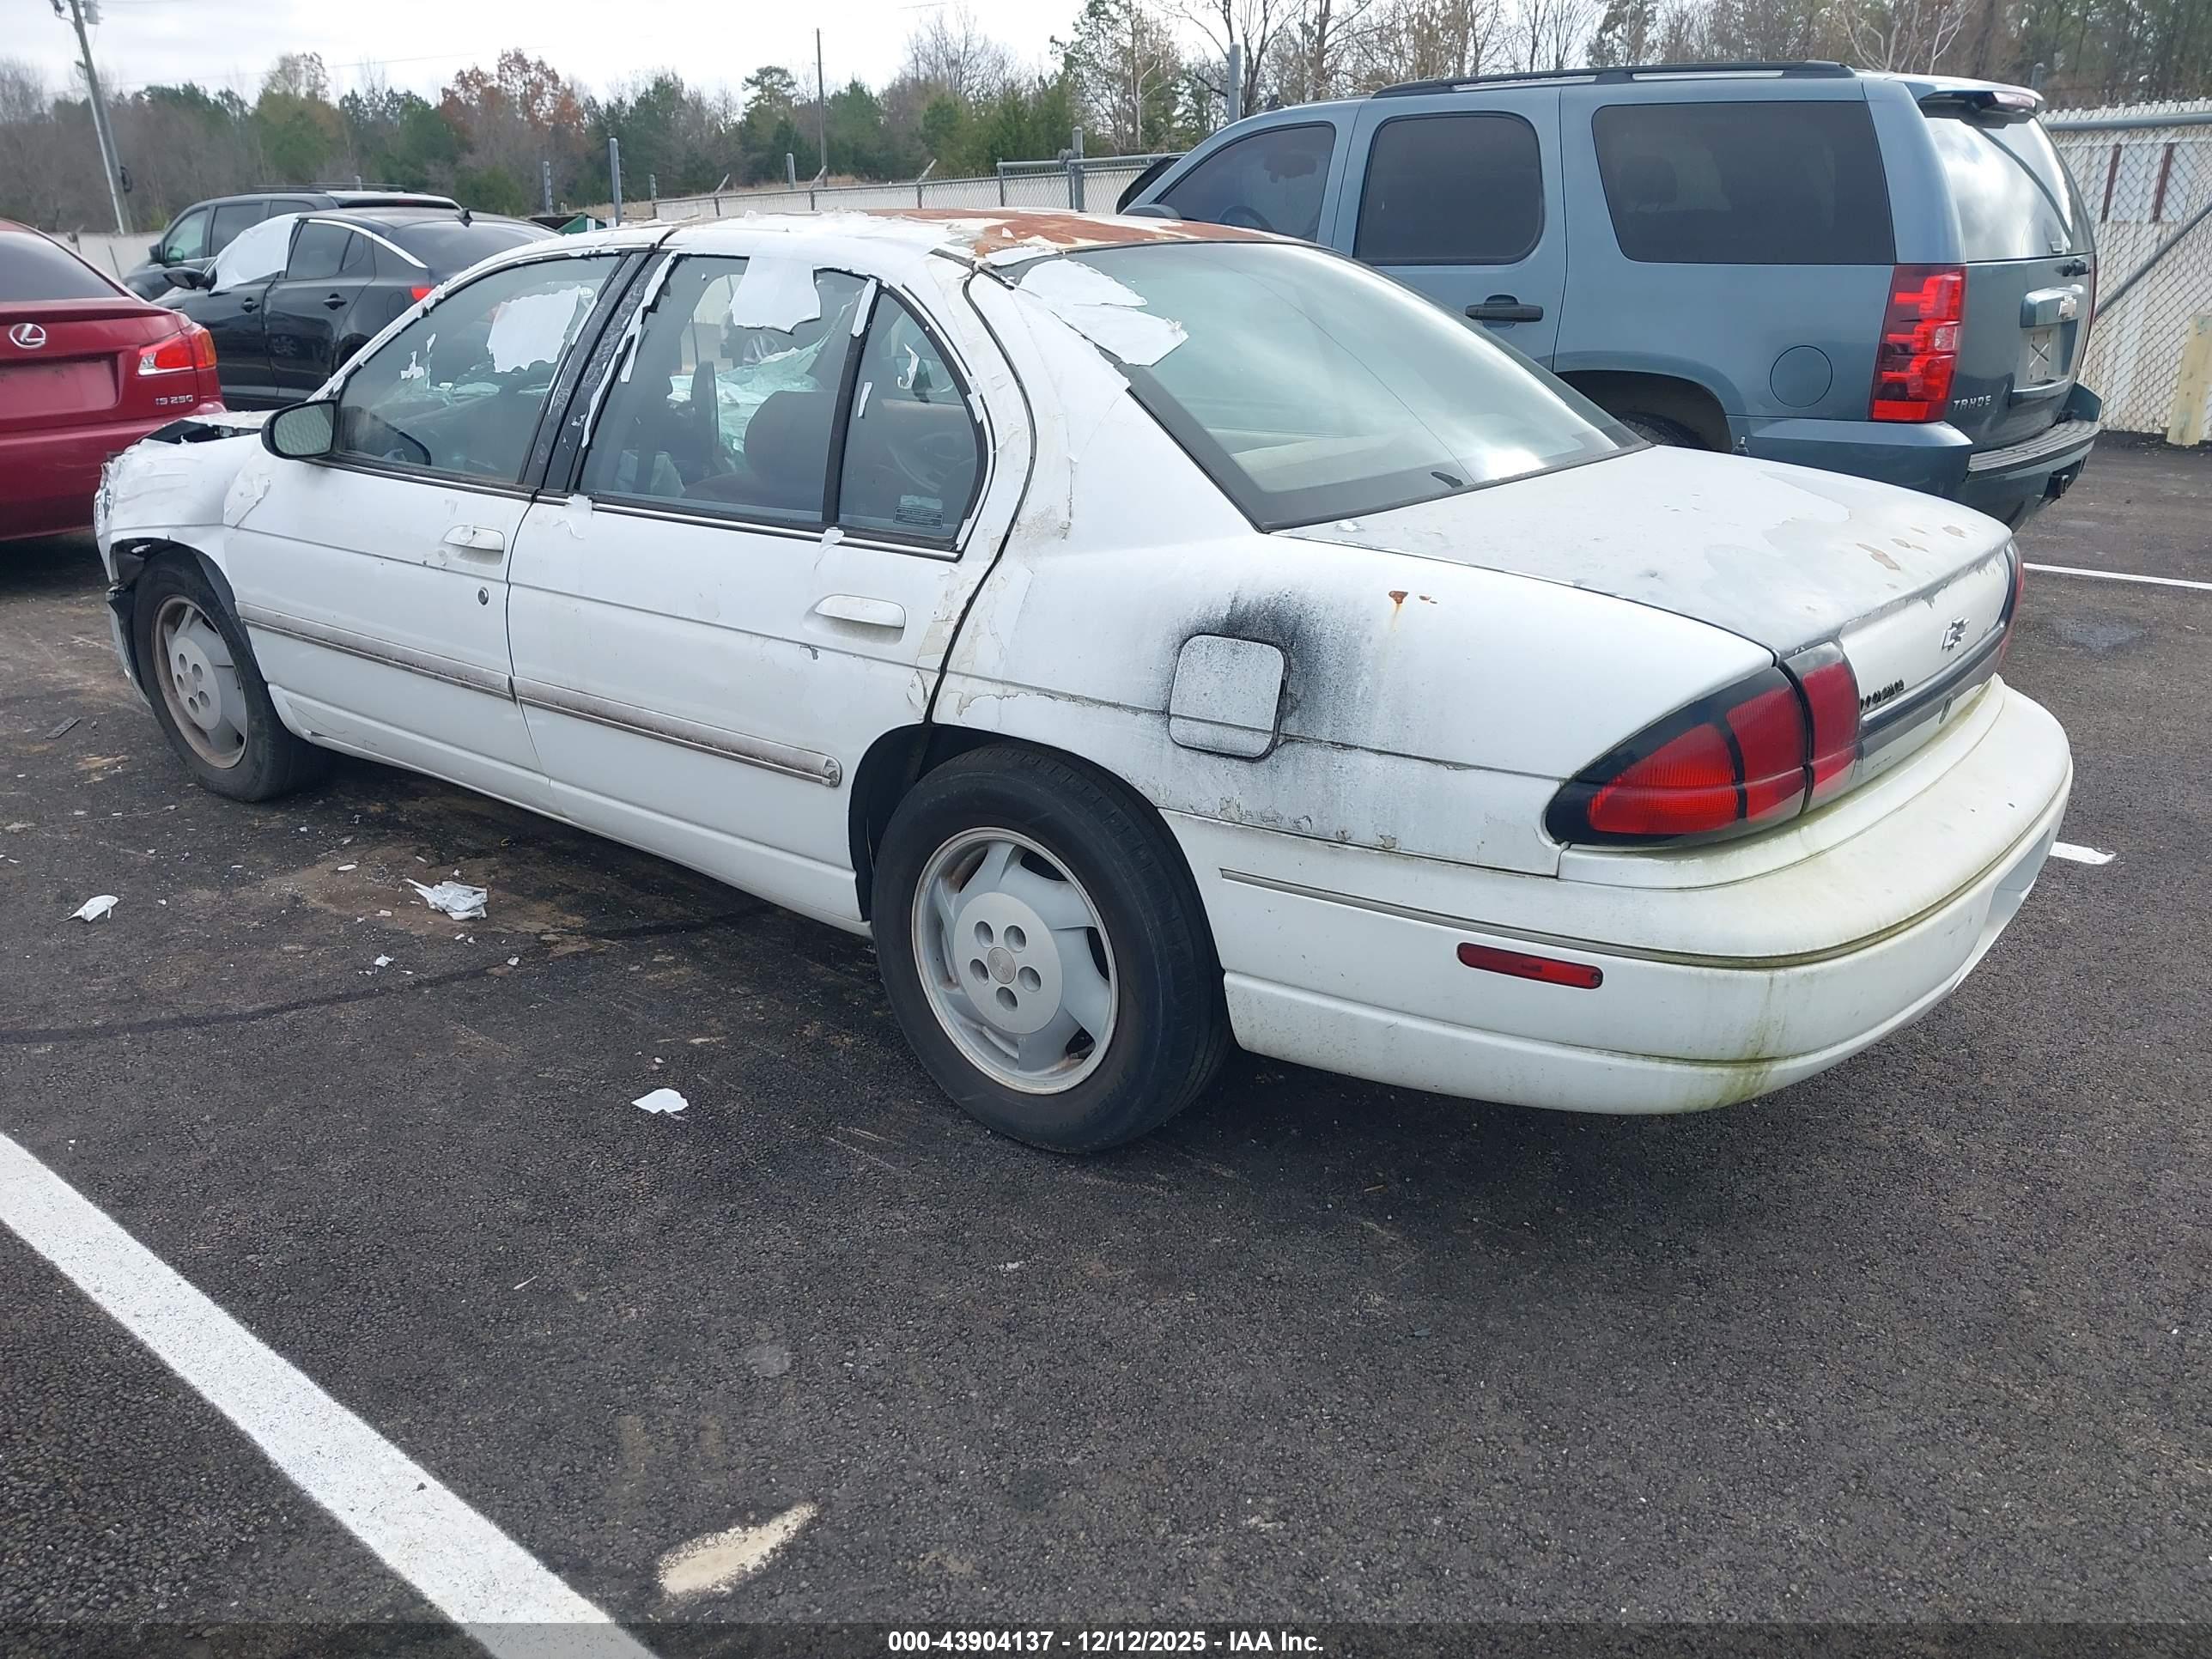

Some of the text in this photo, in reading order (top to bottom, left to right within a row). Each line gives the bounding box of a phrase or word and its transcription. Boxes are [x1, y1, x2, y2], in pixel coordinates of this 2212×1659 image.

[155, 394, 193, 406] IS 250
[1954, 394, 1992, 411] TAHOE
